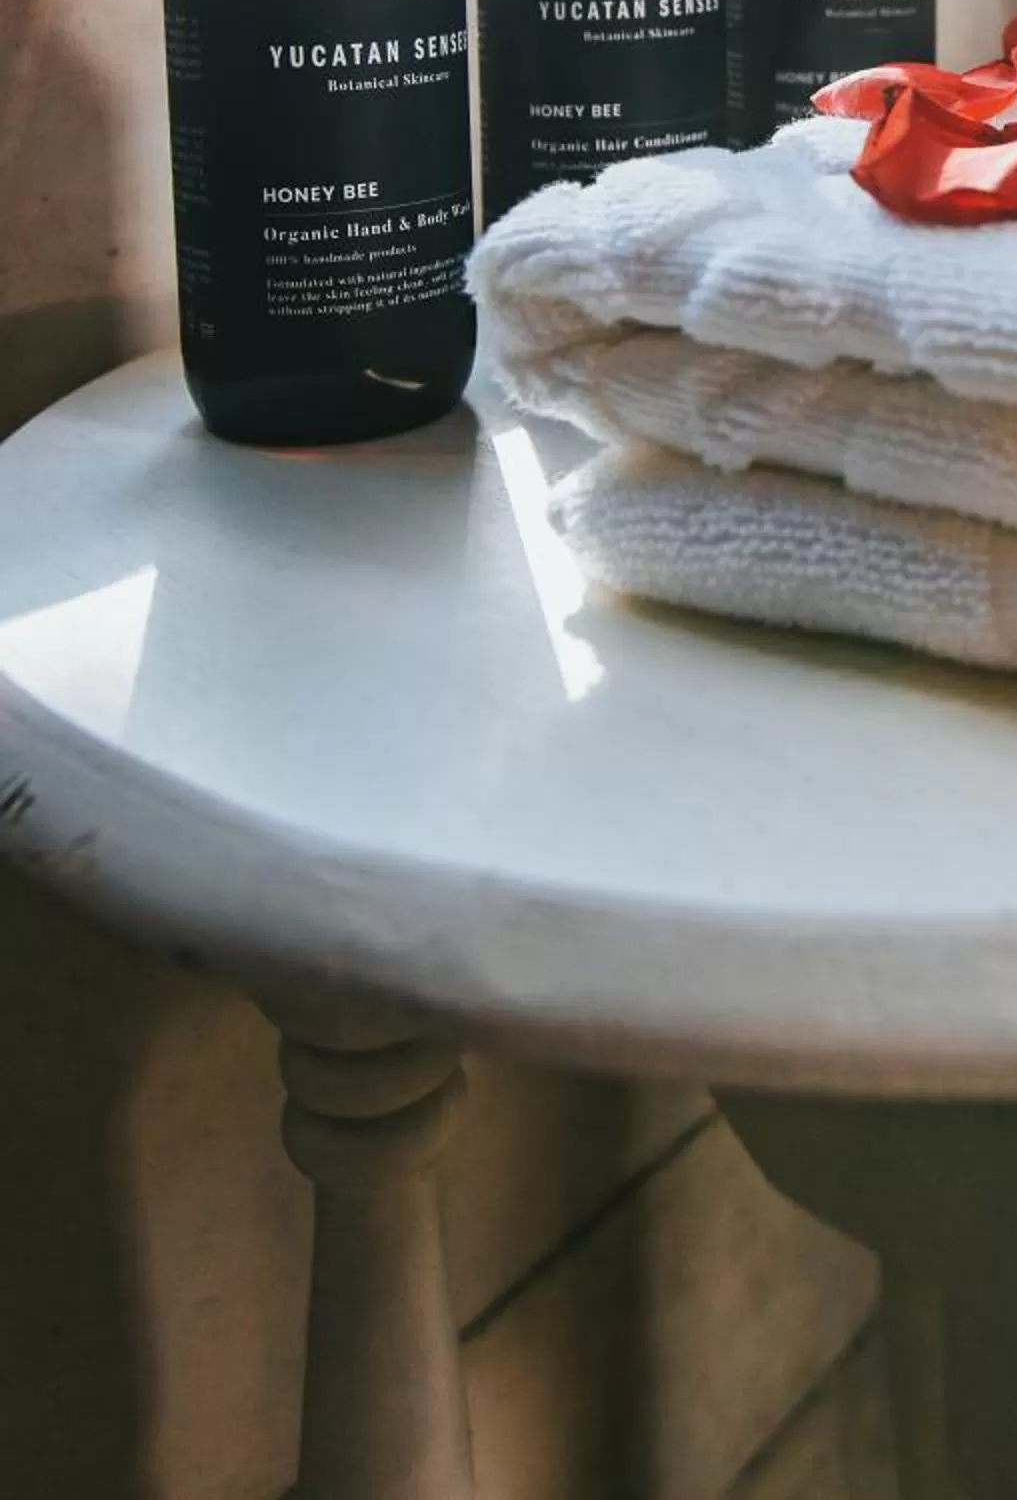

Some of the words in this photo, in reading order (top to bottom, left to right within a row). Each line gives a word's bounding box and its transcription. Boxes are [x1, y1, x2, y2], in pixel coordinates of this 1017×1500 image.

[539, 0, 647, 21] YUCATAN
[269, 38, 400, 69] YUCATAN
[328, 74, 399, 92] Botanical
[529, 103, 585, 119] HONEY
[591, 103, 622, 118] BEE
[531, 139, 590, 156] Organic
[595, 138, 629, 152] Hair
[263, 184, 335, 203] HONEY
[343, 181, 380, 200] BEE
[264, 226, 340, 246] Organic
[346, 217, 393, 238] Hand
[399, 216, 412, 231] &
[417, 208, 449, 228] Body
[369, 243, 417, 263] products
[325, 288, 351, 300] skin
